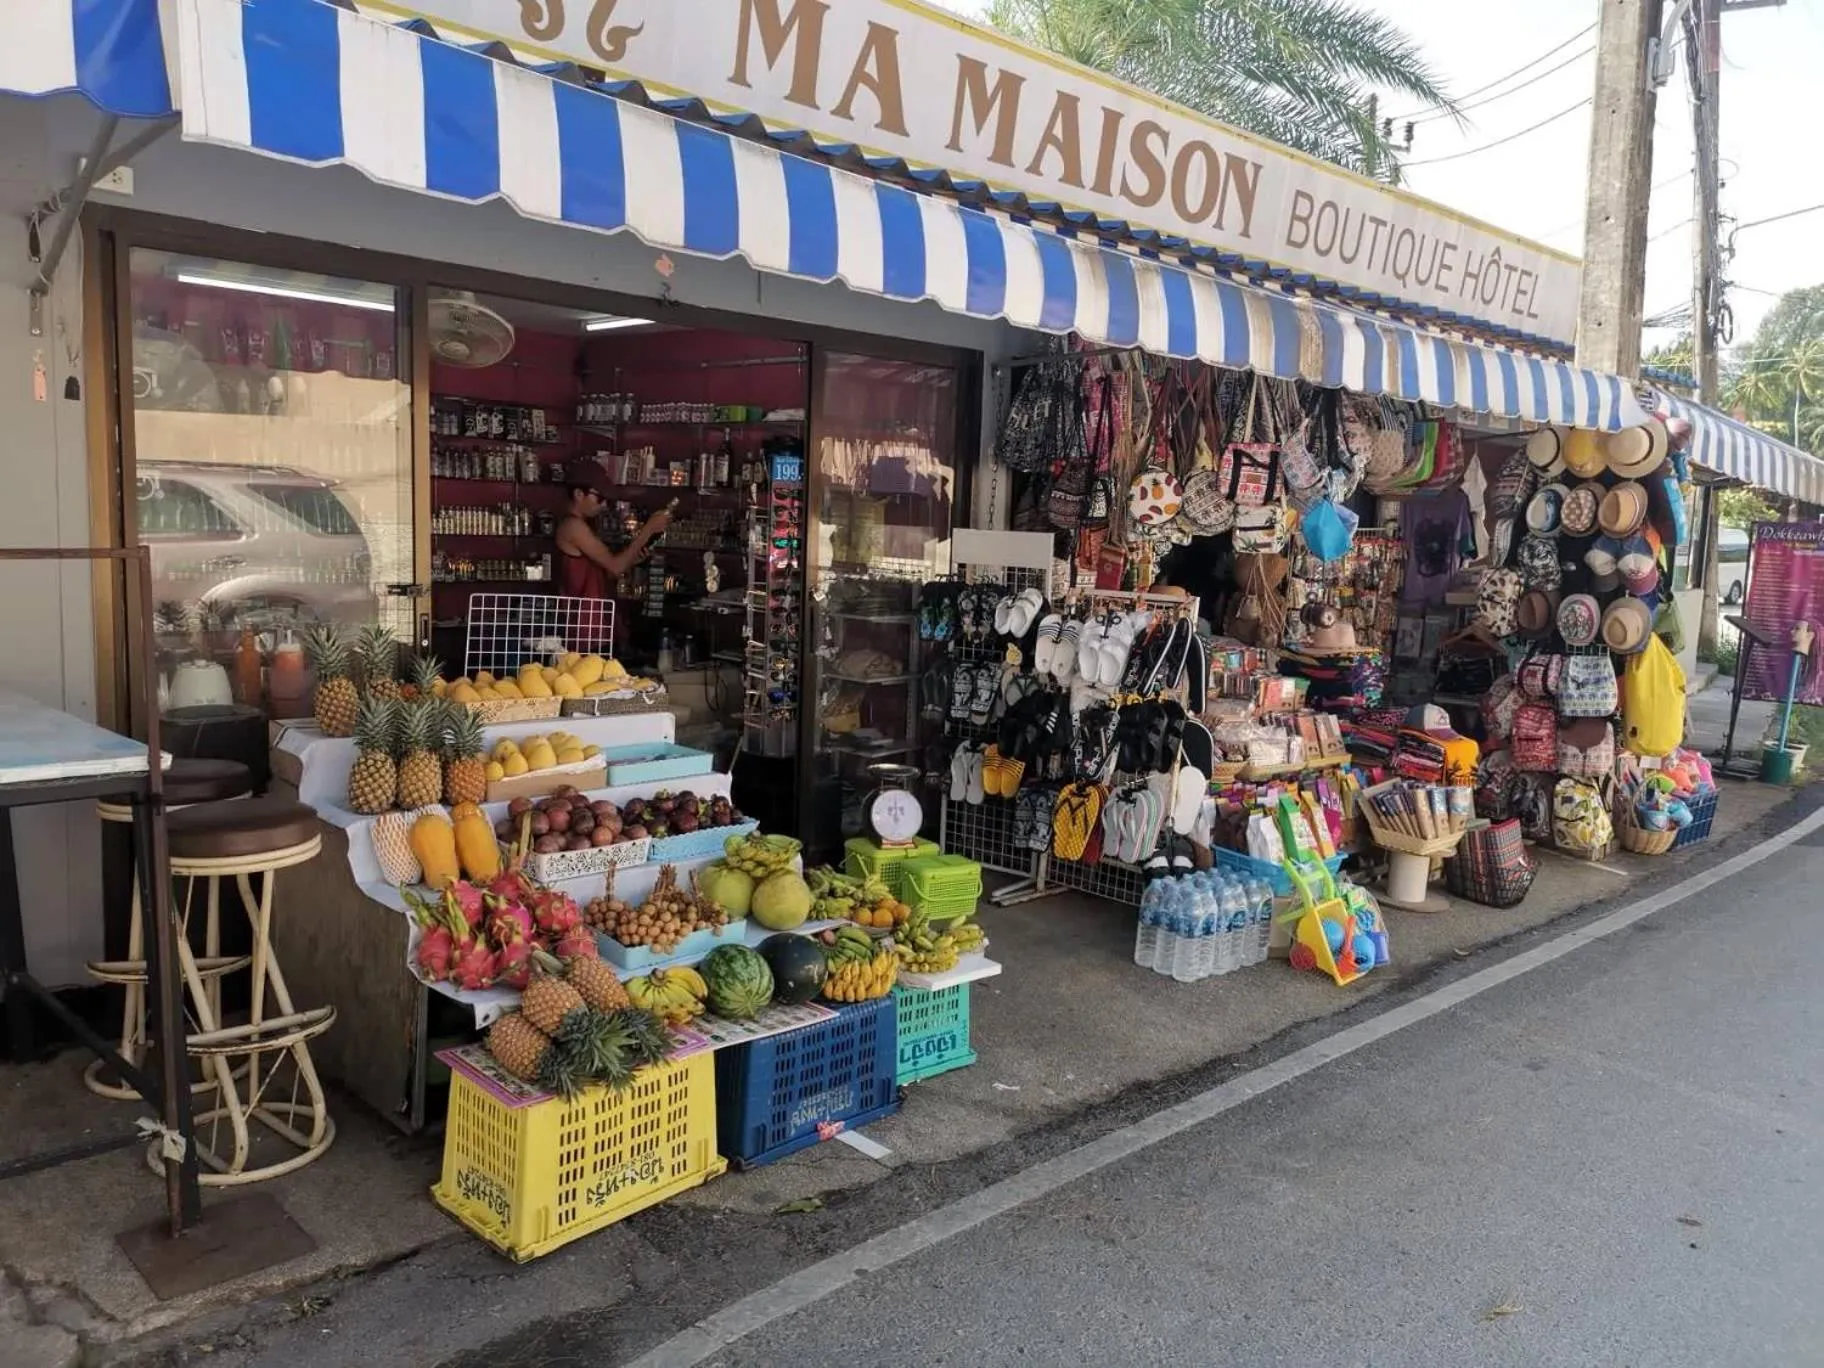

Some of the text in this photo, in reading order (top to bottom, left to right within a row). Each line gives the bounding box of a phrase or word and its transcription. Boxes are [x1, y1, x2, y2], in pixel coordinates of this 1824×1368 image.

[727, 0, 1540, 320] MA MAISON BOUTIQUE HÔTEL
